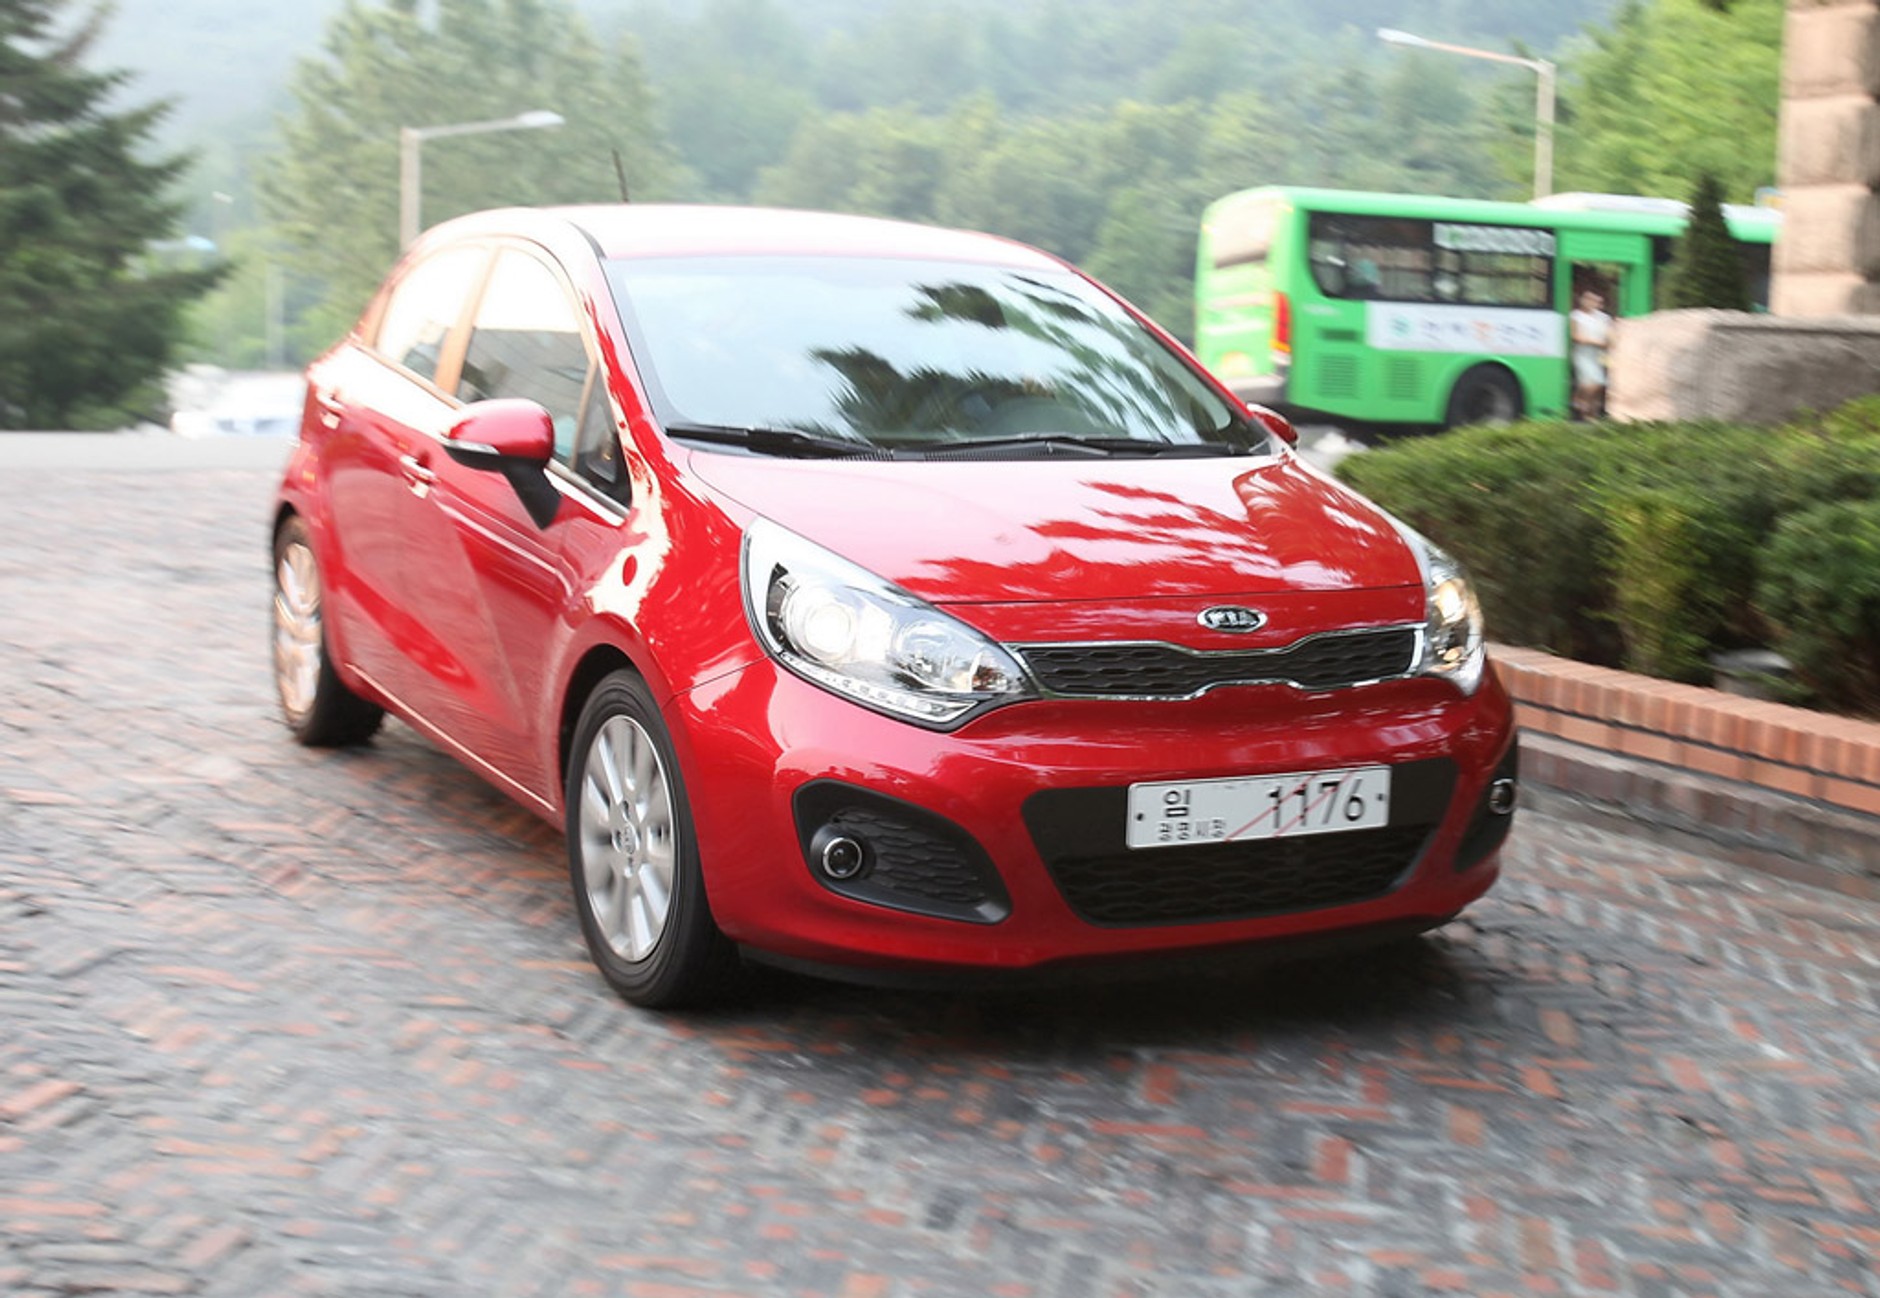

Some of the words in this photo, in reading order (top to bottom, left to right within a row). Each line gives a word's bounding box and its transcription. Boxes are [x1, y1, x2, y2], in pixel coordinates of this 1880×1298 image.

[1207, 611, 1260, 629] KIA
[1163, 789, 1191, 818] 임
[1267, 777, 1366, 829] 1176
